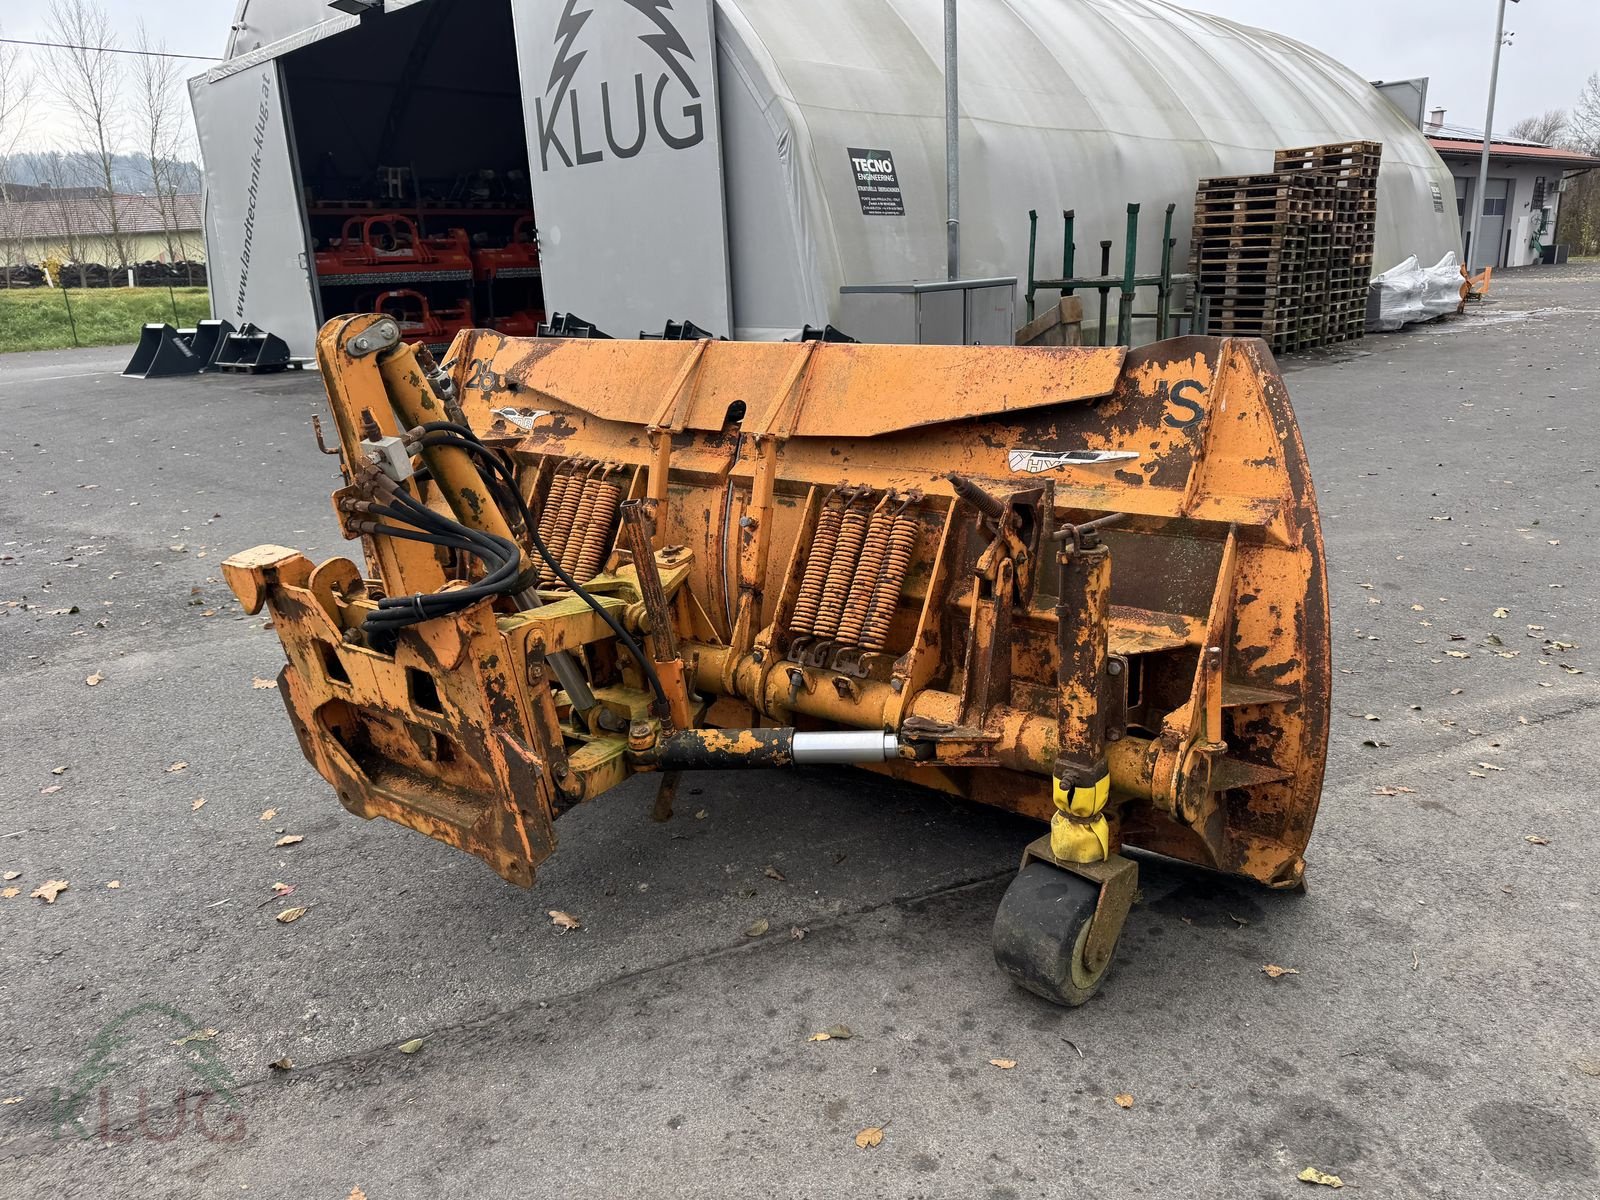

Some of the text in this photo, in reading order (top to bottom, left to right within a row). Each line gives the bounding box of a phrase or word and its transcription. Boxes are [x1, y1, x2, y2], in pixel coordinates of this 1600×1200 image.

[535, 72, 704, 172] KLUG
[851, 157, 893, 174] TECNO
[857, 173, 895, 182] ENGINEERING
[235, 72, 271, 319] www.landtechnik-klug.at
